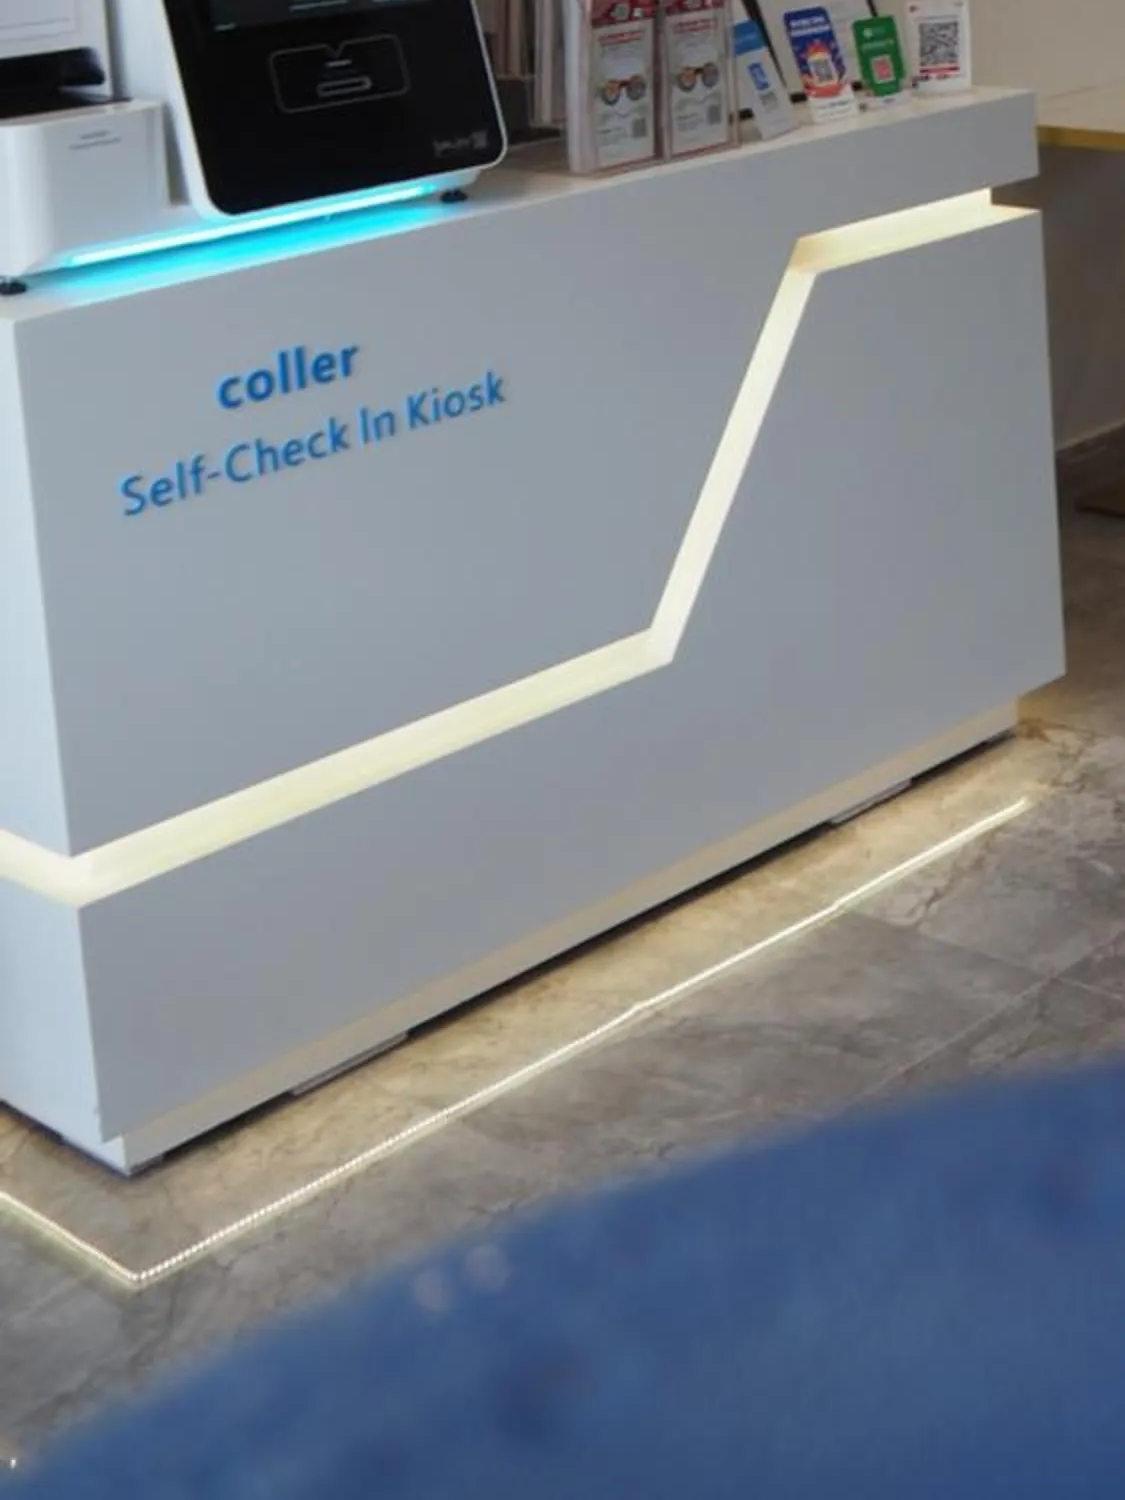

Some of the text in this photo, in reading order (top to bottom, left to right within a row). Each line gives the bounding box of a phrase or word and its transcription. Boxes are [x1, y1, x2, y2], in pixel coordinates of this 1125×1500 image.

[217, 345, 360, 410] coller
[120, 370, 507, 517] Self-Check In Kiosk
